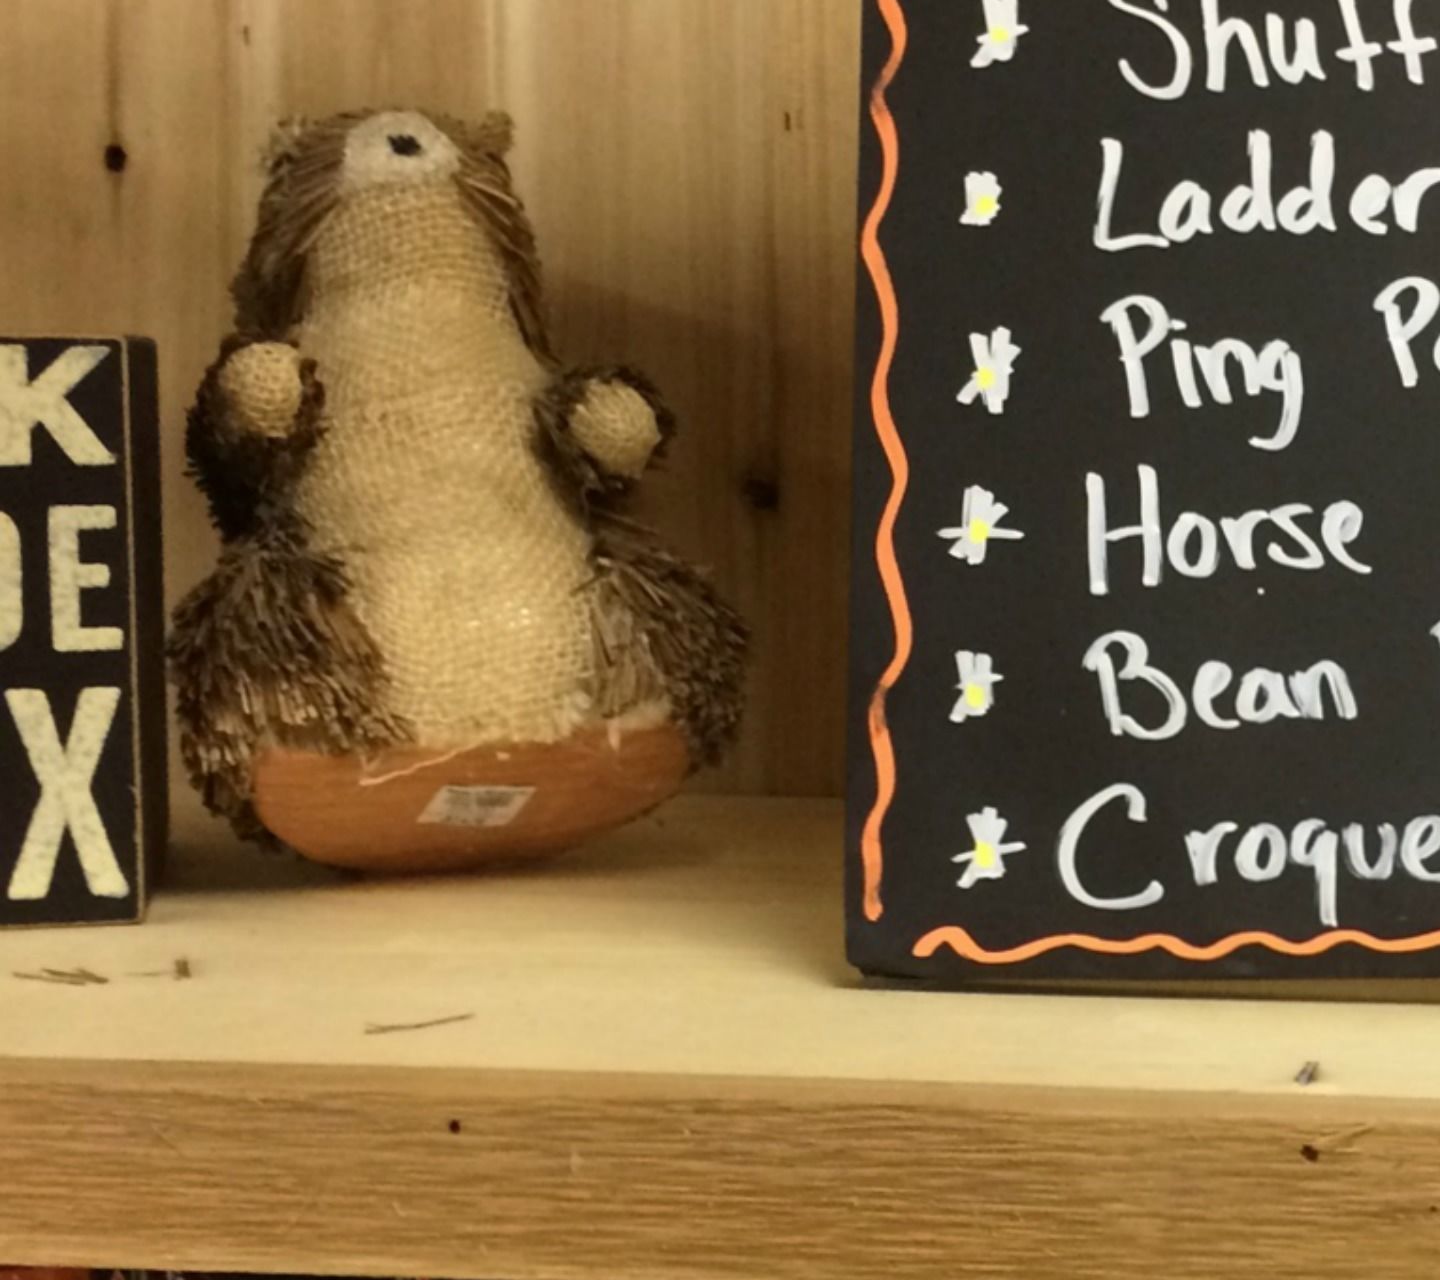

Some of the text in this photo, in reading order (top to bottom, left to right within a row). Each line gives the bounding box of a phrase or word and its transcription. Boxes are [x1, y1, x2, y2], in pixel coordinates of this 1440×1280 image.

[1100, 295, 1303, 450] Ping
[1086, 464, 1371, 595] Horse
[1083, 631, 1357, 739] Bean
